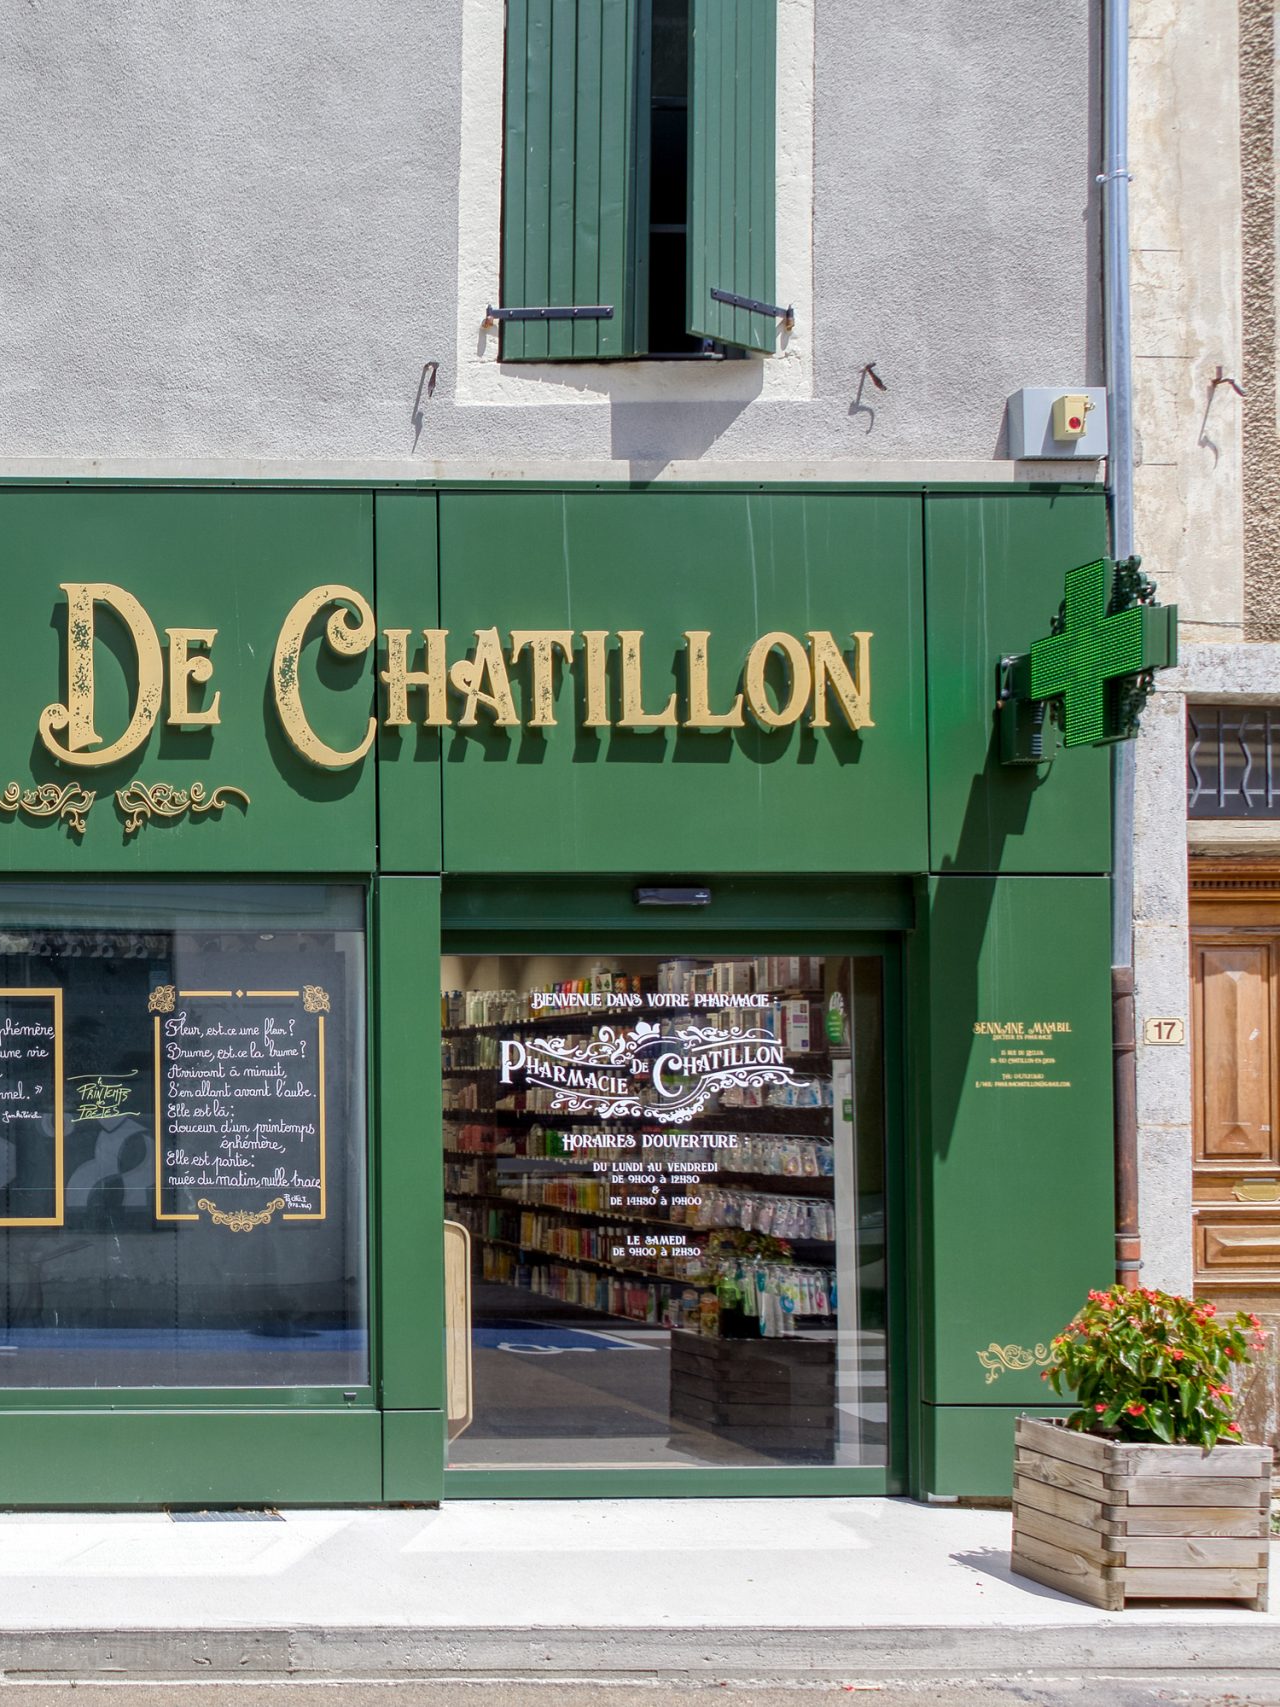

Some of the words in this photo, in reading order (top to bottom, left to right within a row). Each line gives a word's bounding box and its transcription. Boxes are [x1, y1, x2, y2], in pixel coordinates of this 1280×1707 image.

[39, 582, 221, 767] DE
[273, 584, 875, 771] CHATILLON
[531, 992, 602, 1009] BIENVENUE
[607, 993, 643, 1007] DANS
[647, 993, 689, 1007] VOTRE
[694, 993, 770, 1007] PHARMACIE
[238, 1026, 259, 1035] une
[1153, 1021, 1176, 1040] 17
[27, 1046, 49, 1057] vie
[250, 1041, 264, 1058] la
[168, 1062, 226, 1078] Arrivant
[499, 1040, 628, 1095] PHARMACIE
[630, 1058, 649, 1075] DE
[653, 1046, 784, 1098] CHATILLON
[195, 1080, 231, 1097] allant
[234, 1080, 271, 1097] avant
[167, 1103, 190, 1117] Elle
[193, 1104, 212, 1117] est
[169, 1120, 218, 1133] douceur
[221, 1119, 250, 1133] d'un
[253, 1119, 315, 1142] printemps
[563, 1134, 636, 1151] HORAIRES
[642, 1134, 738, 1148] D'OUVERTURE
[166, 1150, 189, 1166] Elle
[191, 1151, 210, 1165] est
[593, 1163, 607, 1172] DU
[612, 1163, 643, 1172] LUNDI
[647, 1163, 662, 1172] AU
[668, 1163, 718, 1172] VENDREDI
[168, 1171, 195, 1185] nuée
[197, 1171, 214, 1185] du
[261, 1167, 289, 1186] nulle
[612, 1175, 624, 1184] DE
[628, 1175, 655, 1184] 9H00
[659, 1174, 667, 1184] à
[651, 1185, 660, 1195] &
[610, 1197, 623, 1206] DE
[660, 1196, 667, 1206] à
[627, 1235, 640, 1245] LE
[645, 1235, 686, 1245] SAMEDI
[613, 1248, 625, 1257] DE
[629, 1248, 656, 1257] 9H00
[660, 1247, 667, 1257] à
